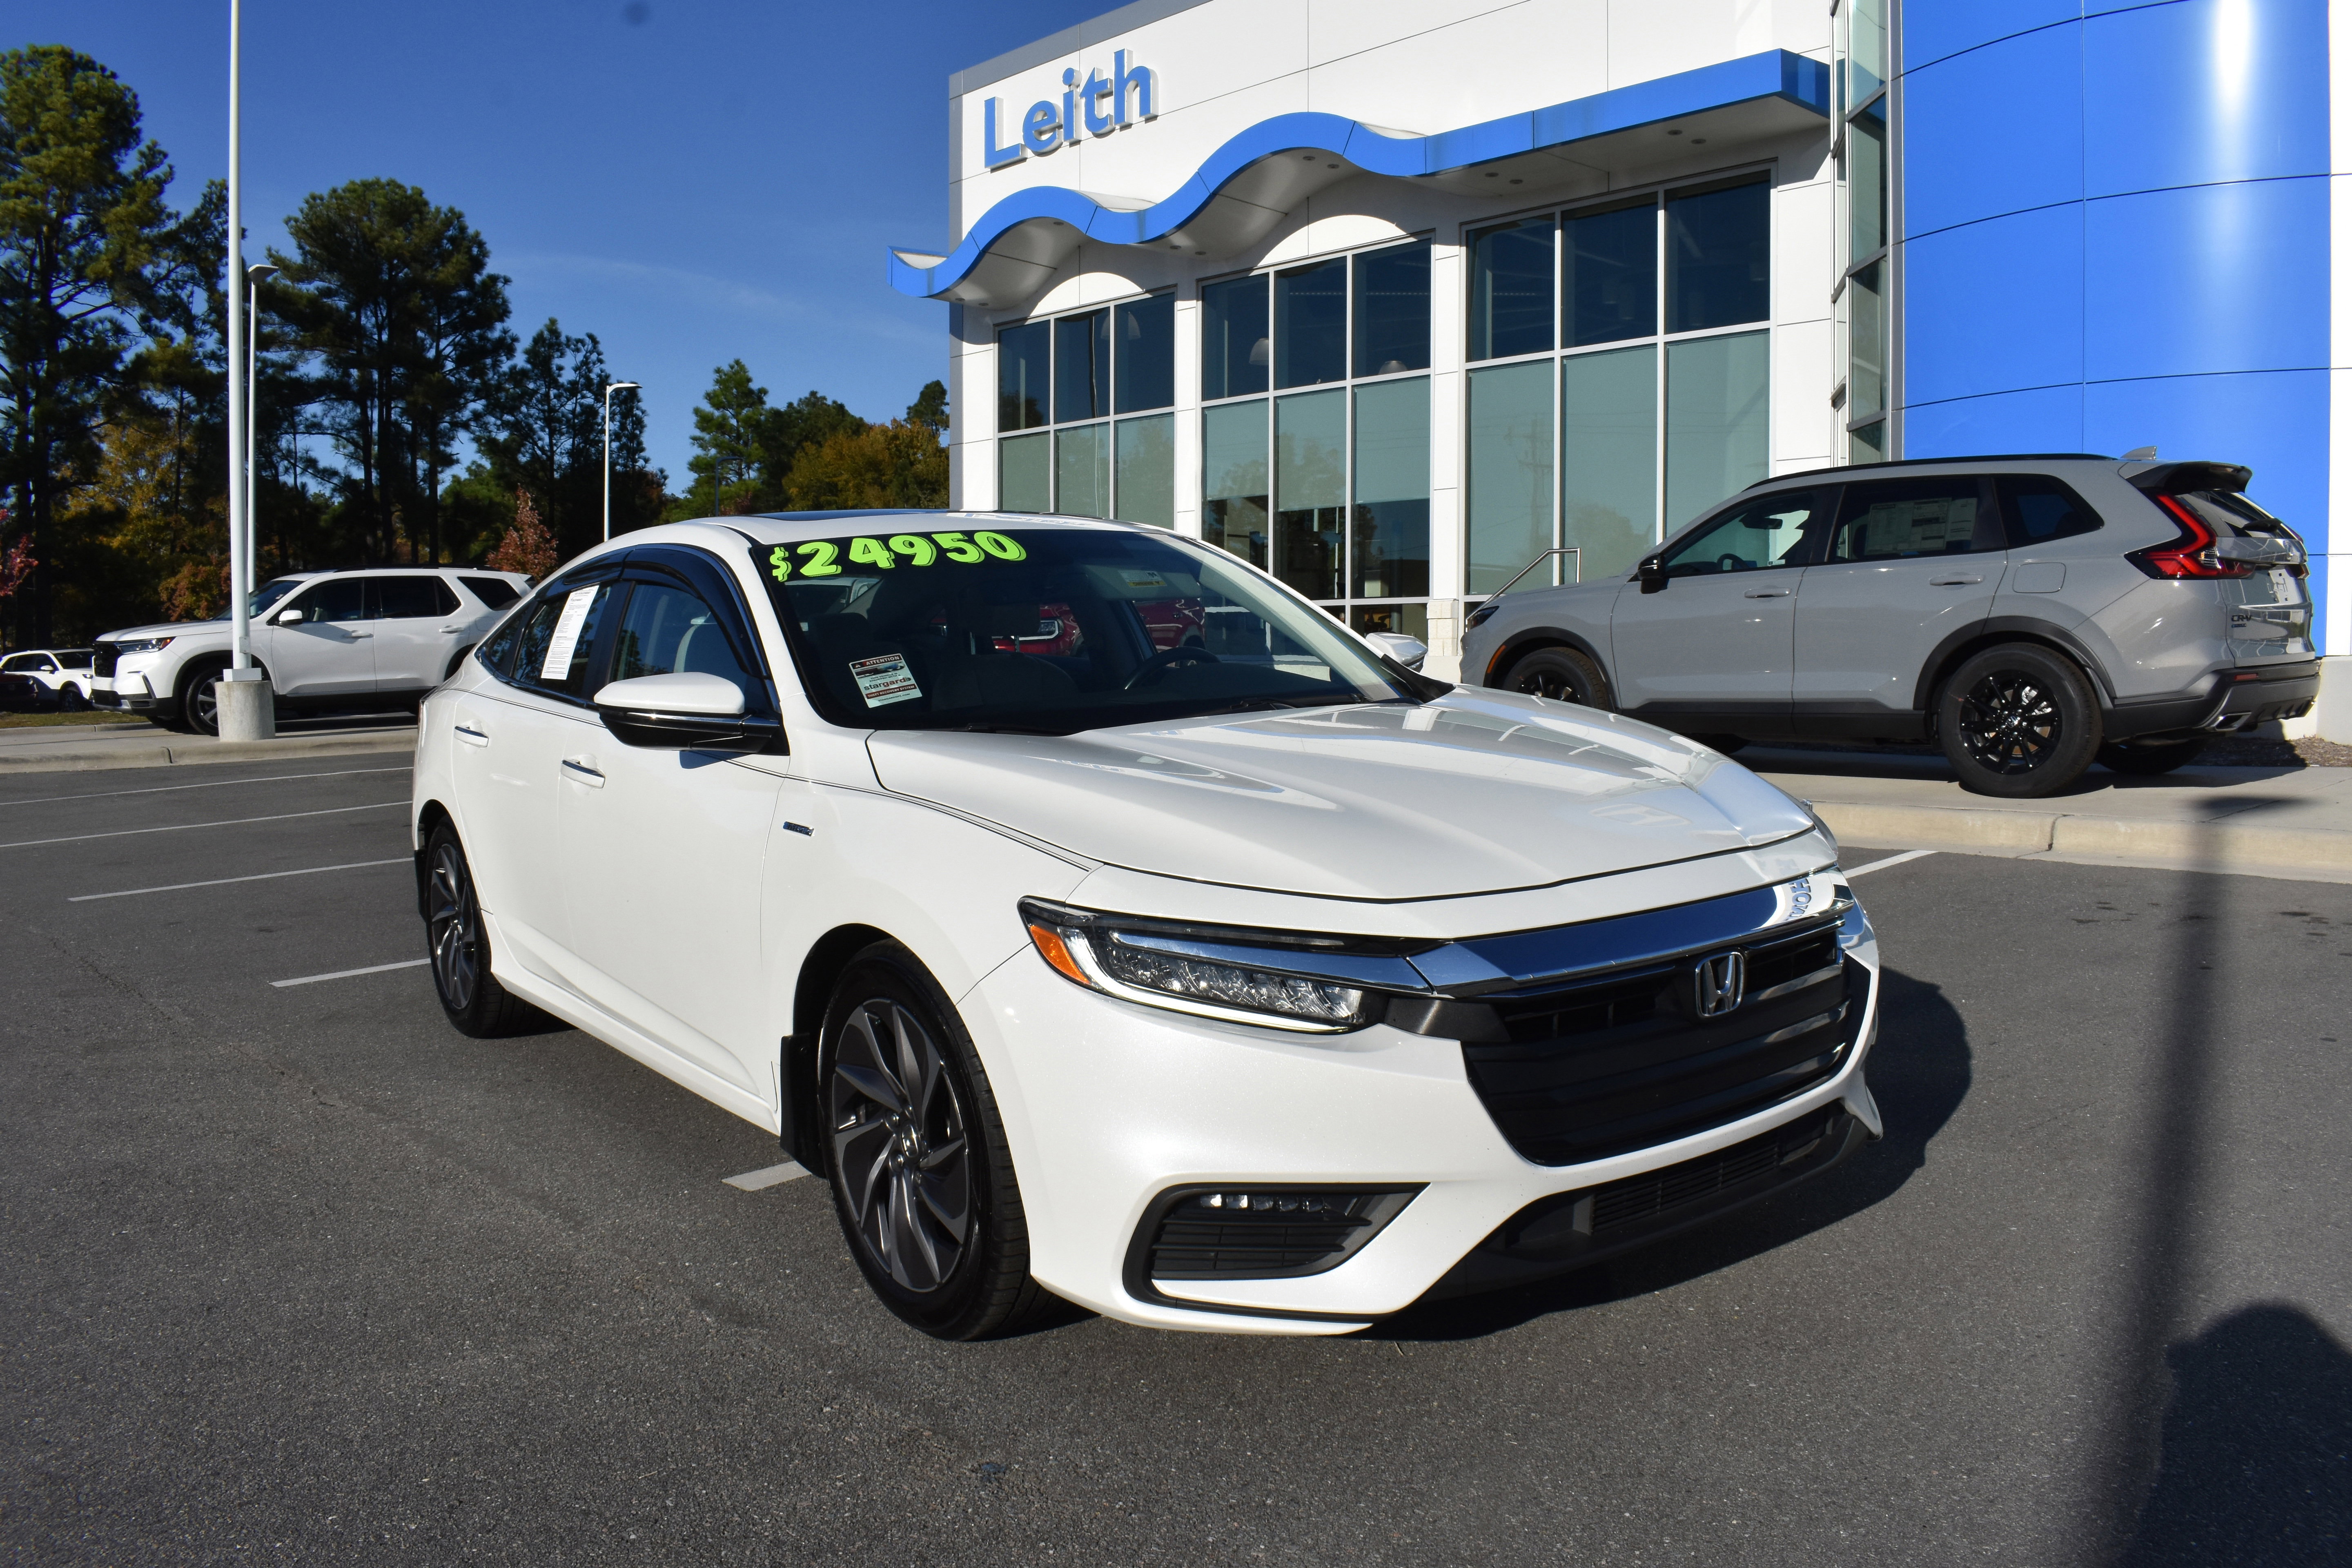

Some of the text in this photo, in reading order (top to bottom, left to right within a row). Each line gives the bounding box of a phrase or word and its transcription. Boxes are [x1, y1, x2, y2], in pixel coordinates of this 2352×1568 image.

[984, 48, 1158, 169] Leith
[770, 531, 1027, 582] $24950
[866, 655, 900, 666] ATTENTION
[864, 677, 906, 690] stargard
